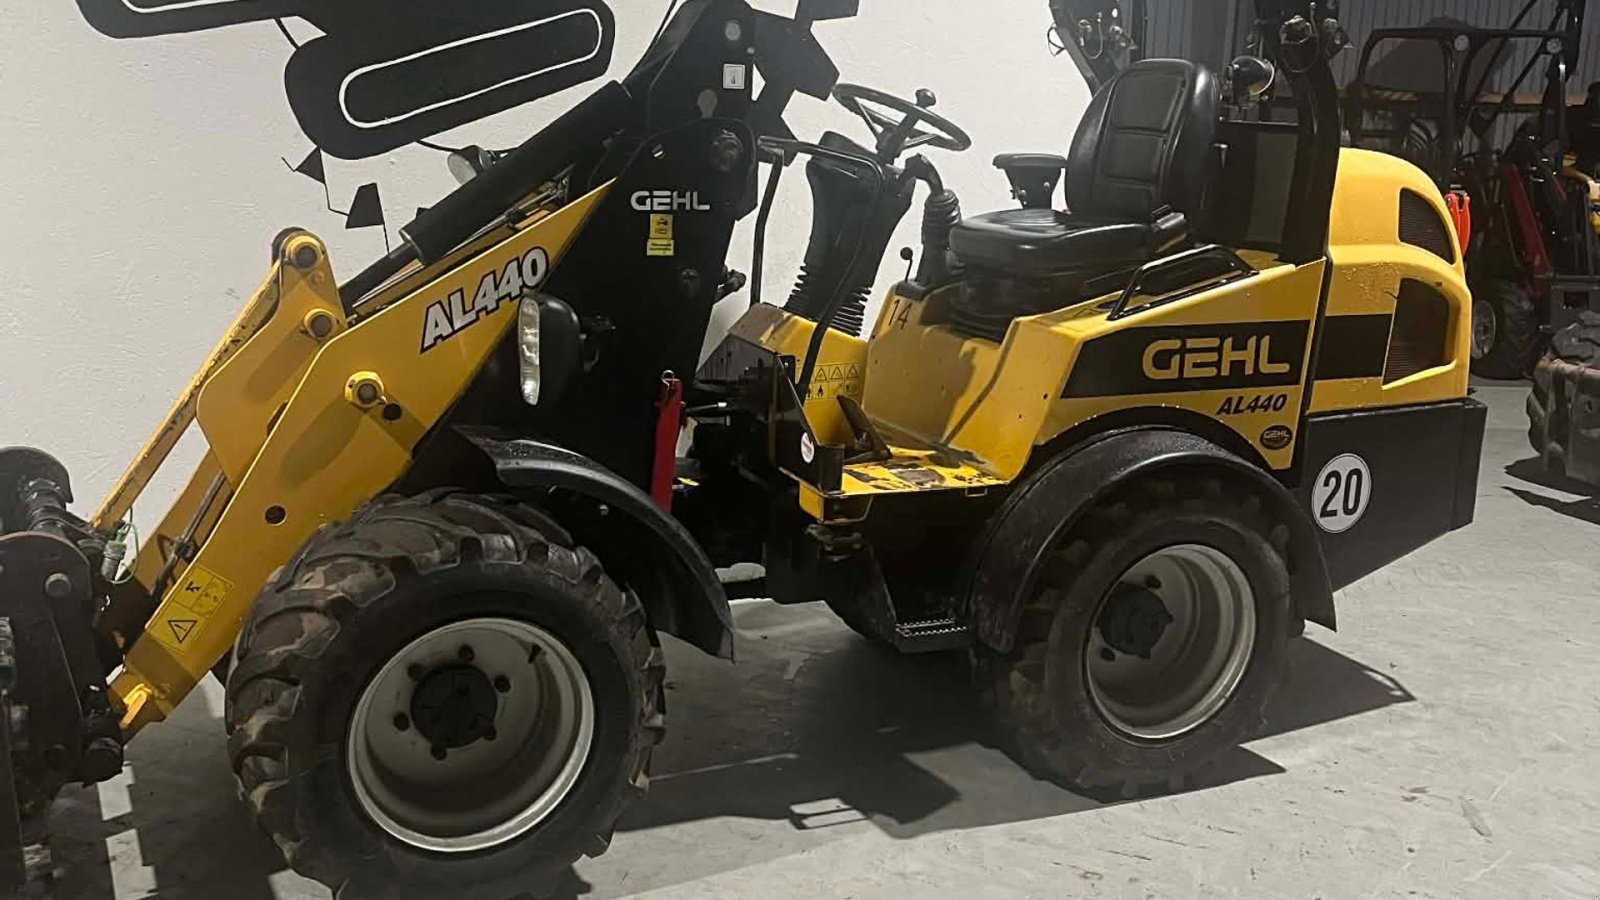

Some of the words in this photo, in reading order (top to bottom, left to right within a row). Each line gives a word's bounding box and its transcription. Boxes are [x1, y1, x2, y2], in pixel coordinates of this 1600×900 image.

[630, 190, 711, 211] GEHL
[420, 246, 549, 355] AL440
[888, 299, 913, 330] 14
[1142, 334, 1291, 380] GEHL
[1216, 393, 1288, 416] AL440
[1319, 467, 1363, 518] 20
